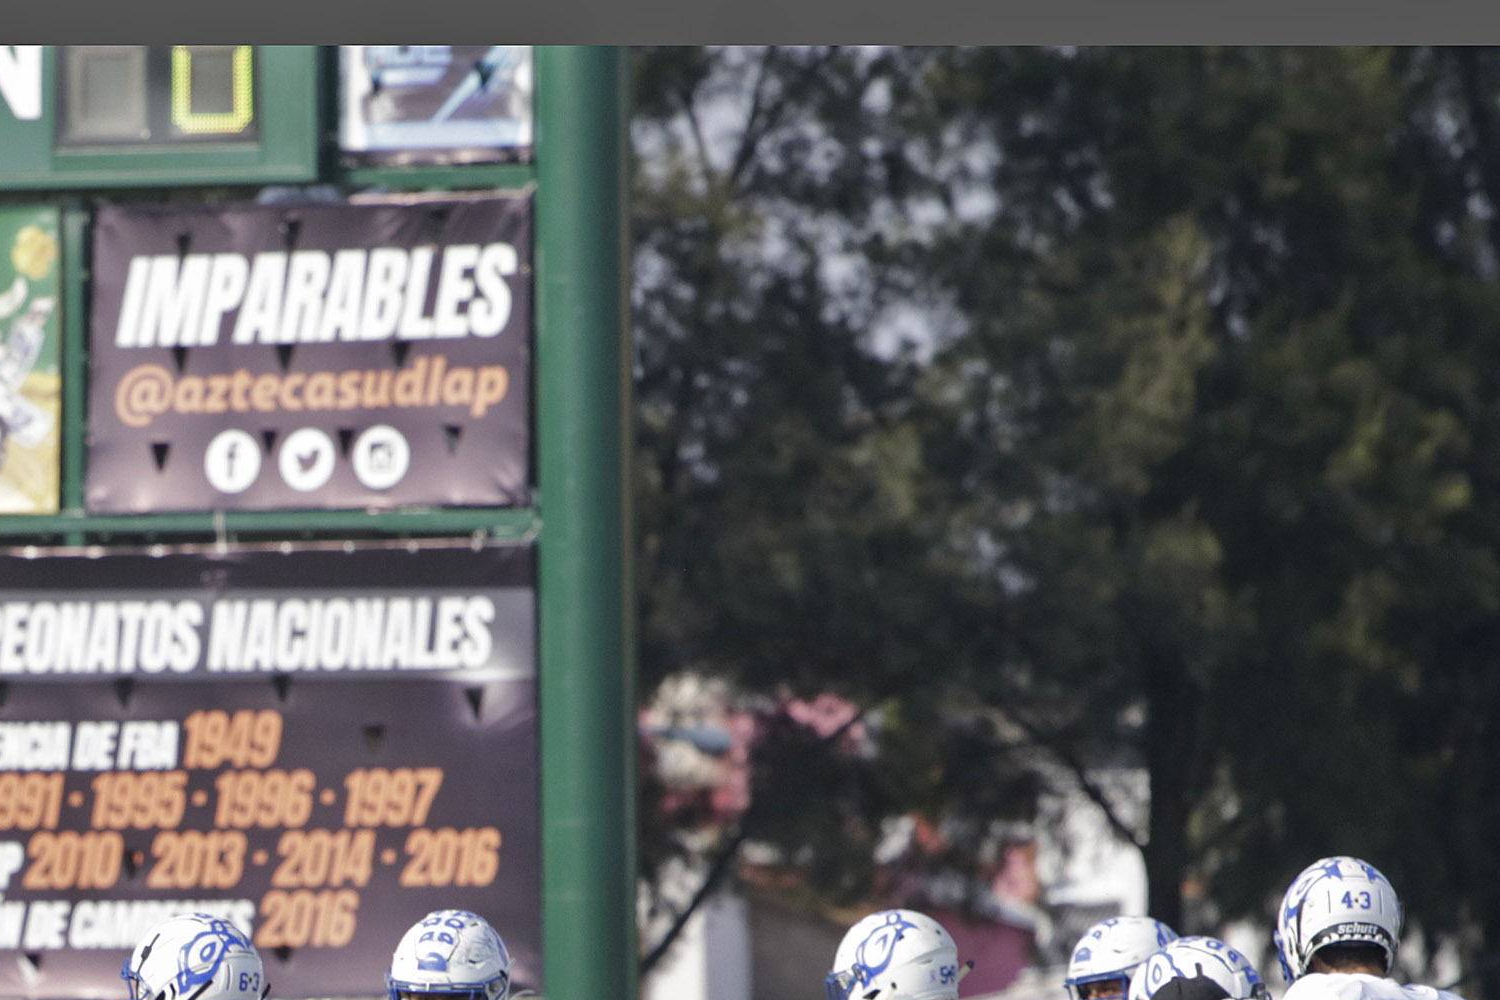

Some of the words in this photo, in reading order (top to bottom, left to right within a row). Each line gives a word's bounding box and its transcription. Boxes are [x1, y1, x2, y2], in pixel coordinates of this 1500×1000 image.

[115, 243, 517, 348] IMPARABLES
[115, 355, 508, 427] @aztecasudlap
[206, 597, 496, 672] NACIONALES
[71, 721, 119, 772] DE
[183, 709, 283, 770] 1949
[91, 770, 188, 830] 1995
[214, 768, 316, 829] 1996
[343, 766, 444, 828] 1997
[21, 829, 124, 889] 2010
[146, 829, 247, 889] 2013
[271, 828, 376, 888] 2014
[400, 826, 502, 887] 2016
[23, 900, 73, 950] DE
[253, 888, 359, 948] 2016
[1336, 923, 1379, 935] schutt
[1340, 890, 1371, 909] 43
[238, 972, 261, 992] 63
